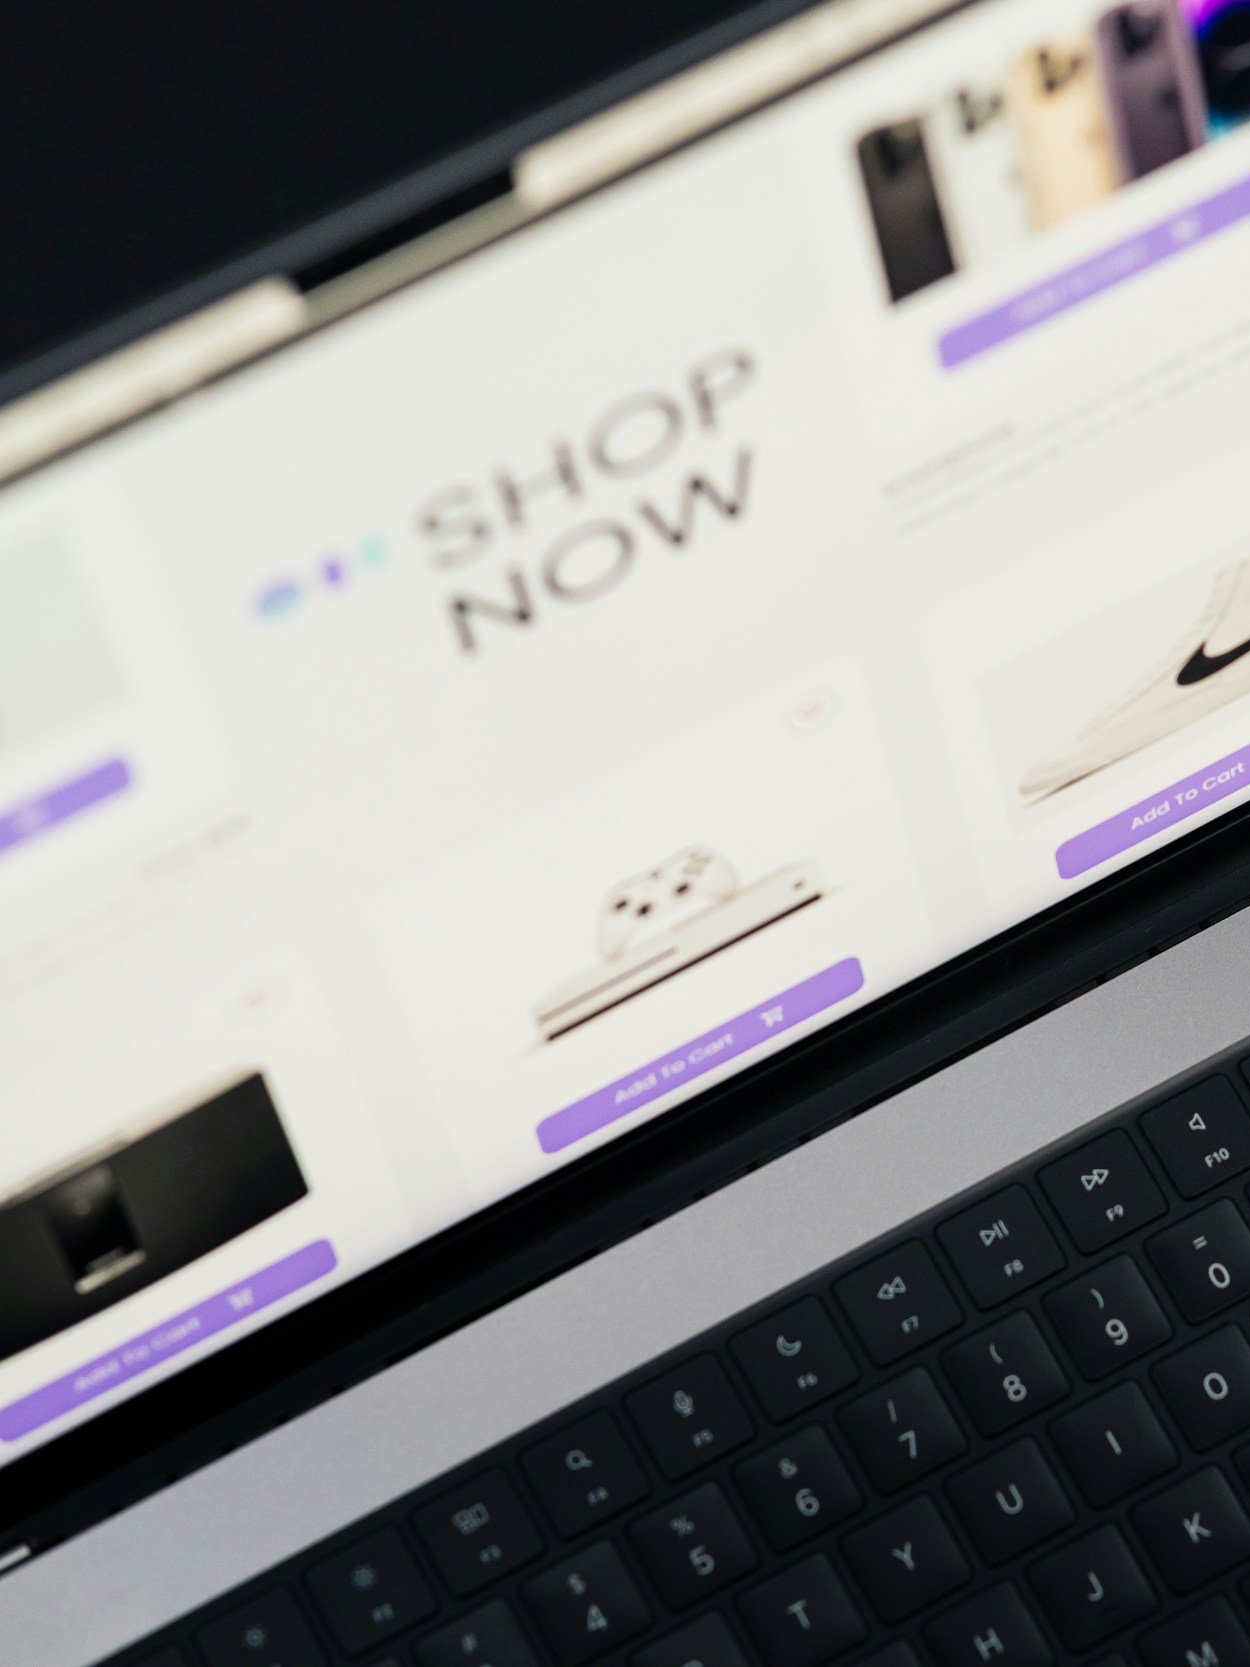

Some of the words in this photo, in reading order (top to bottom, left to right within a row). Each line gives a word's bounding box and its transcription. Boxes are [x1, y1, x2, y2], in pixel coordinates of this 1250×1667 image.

[415, 347, 756, 570] SHOP
[447, 443, 758, 657] NOW
[1131, 801, 1170, 831] Add
[1174, 787, 1199, 805] To
[1202, 762, 1246, 791] Cart
[1204, 1147, 1230, 1168] F10
[1105, 1204, 1124, 1222] F9
[1003, 1259, 1024, 1277] F8
[1208, 1262, 1231, 1289] 0
[901, 1315, 919, 1334] F7
[1104, 1318, 1129, 1346] 9
[1002, 1374, 1028, 1402] 8
[1202, 1372, 1229, 1401] O
[898, 1429, 917, 1458] 7
[1105, 1430, 1122, 1455] I
[795, 1487, 820, 1517] 6
[995, 1483, 1024, 1515] U
[1183, 1512, 1211, 1542] K
[689, 1545, 715, 1576] 5
[893, 1542, 915, 1570] Y
[1088, 1571, 1104, 1602] J
[587, 1604, 608, 1631] 4
[787, 1599, 810, 1628] T
[974, 1628, 1004, 1660] H
